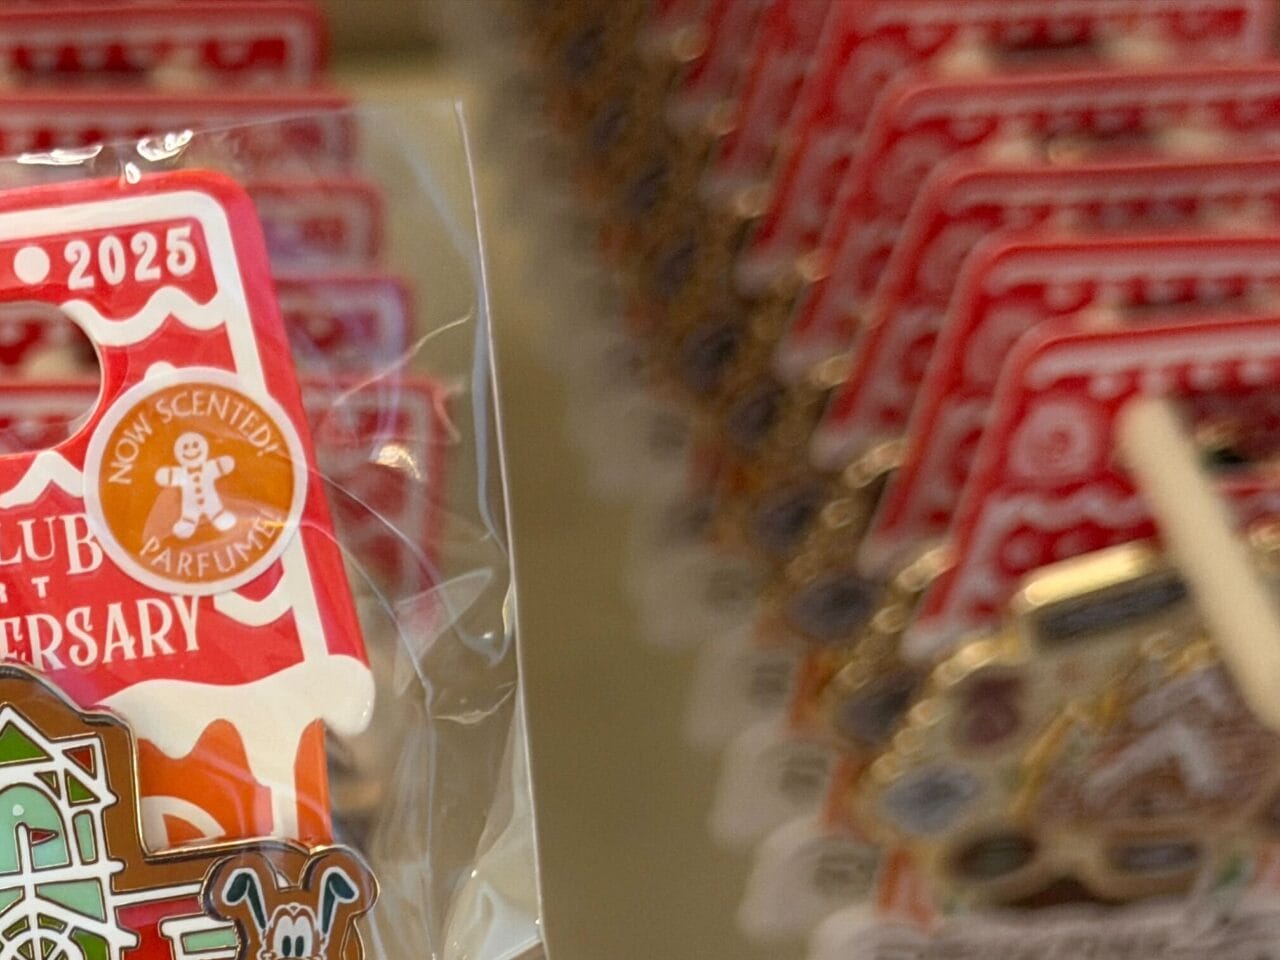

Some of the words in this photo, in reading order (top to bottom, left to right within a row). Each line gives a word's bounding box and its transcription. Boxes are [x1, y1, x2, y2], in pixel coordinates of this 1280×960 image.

[64, 225, 196, 290] 2025
[108, 413, 153, 485] NOW
[155, 390, 279, 457] SCENTED!
